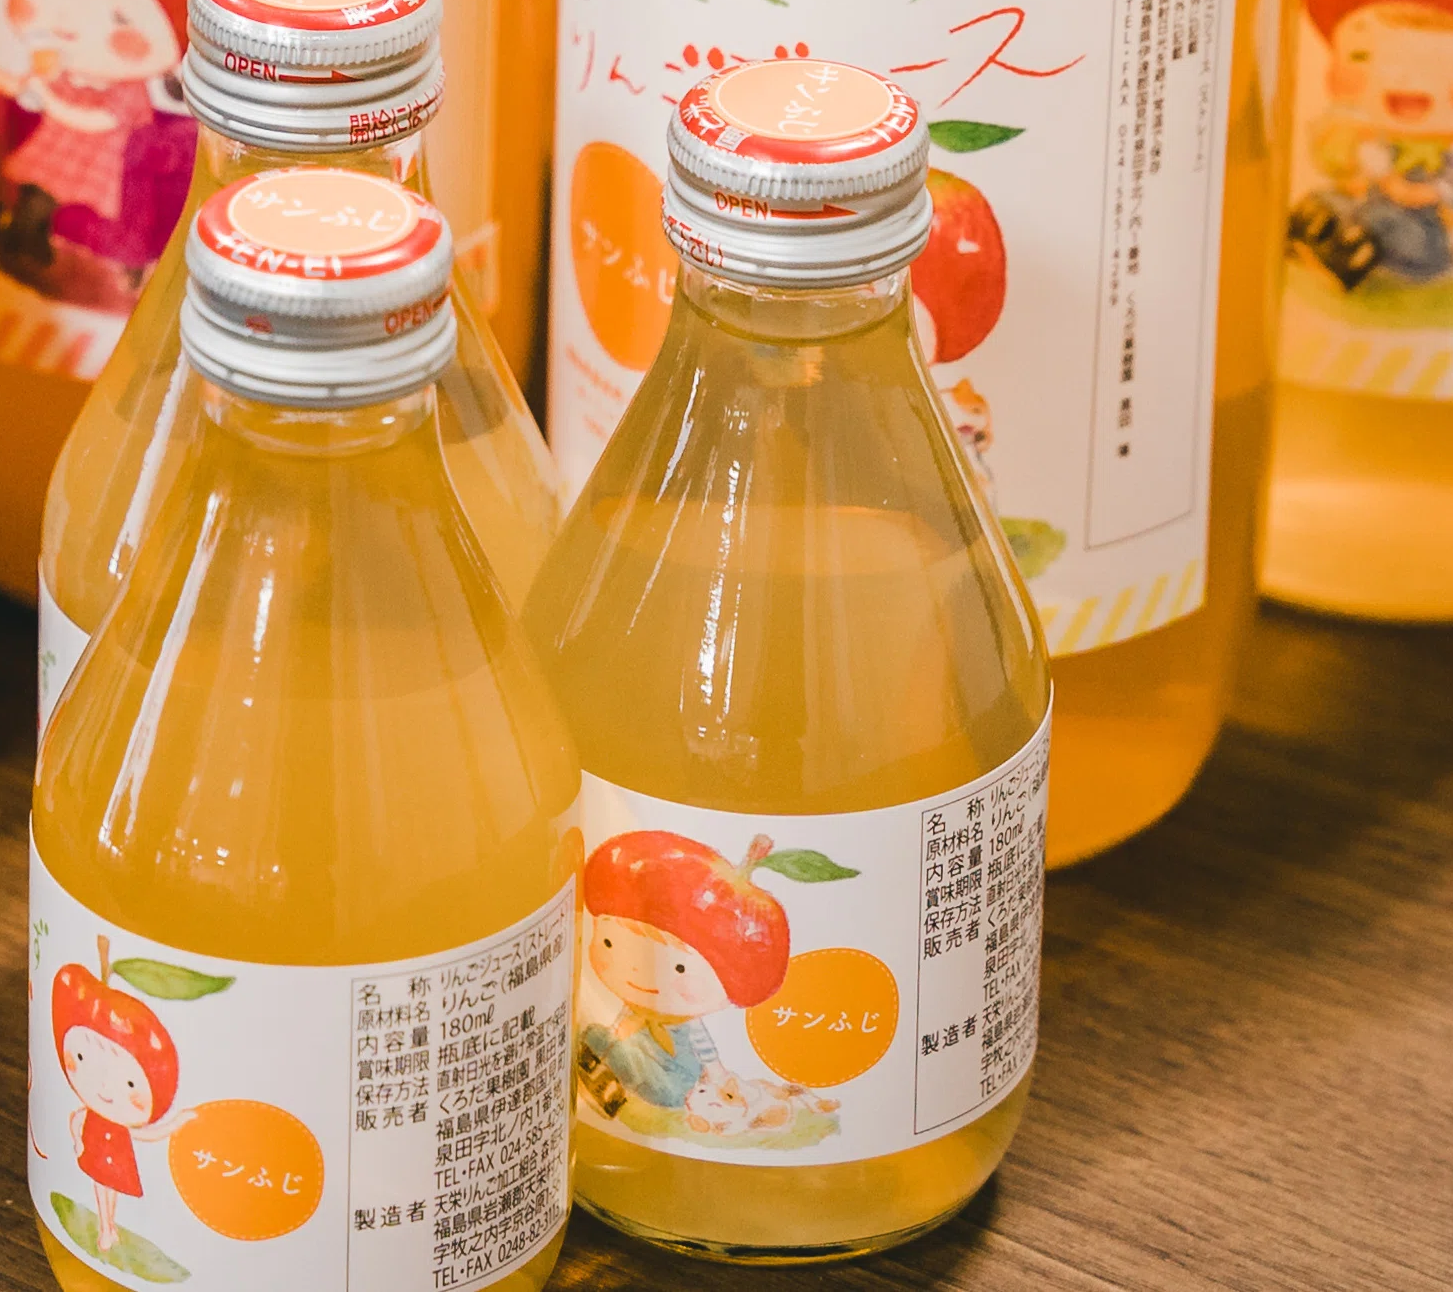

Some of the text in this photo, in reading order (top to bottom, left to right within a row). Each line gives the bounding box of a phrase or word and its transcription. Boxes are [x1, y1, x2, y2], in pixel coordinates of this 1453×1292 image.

[223, 51, 277, 83] OPEN
[244, 189, 401, 232] サンふじ
[714, 190, 769, 220] OPEN
[384, 301, 433, 336] OPEN
[925, 821, 984, 862] 原材料名
[925, 844, 983, 886] 内容量
[925, 868, 983, 911] 賞味期限
[924, 893, 982, 935] 保存方法
[923, 918, 981, 960] 販売者
[357, 1001, 430, 1031] 原材料名
[772, 1005, 880, 1035] サンふじ
[920, 1012, 978, 1056] 製造者
[357, 1005, 535, 1081] 賞味期限 瓶底に記載
[358, 1026, 428, 1056] 内容量
[355, 1076, 429, 1106] 保存方法
[355, 1101, 428, 1131] 販売者
[193, 1146, 305, 1197] サンふじ
[354, 1200, 426, 1231] 製造者
